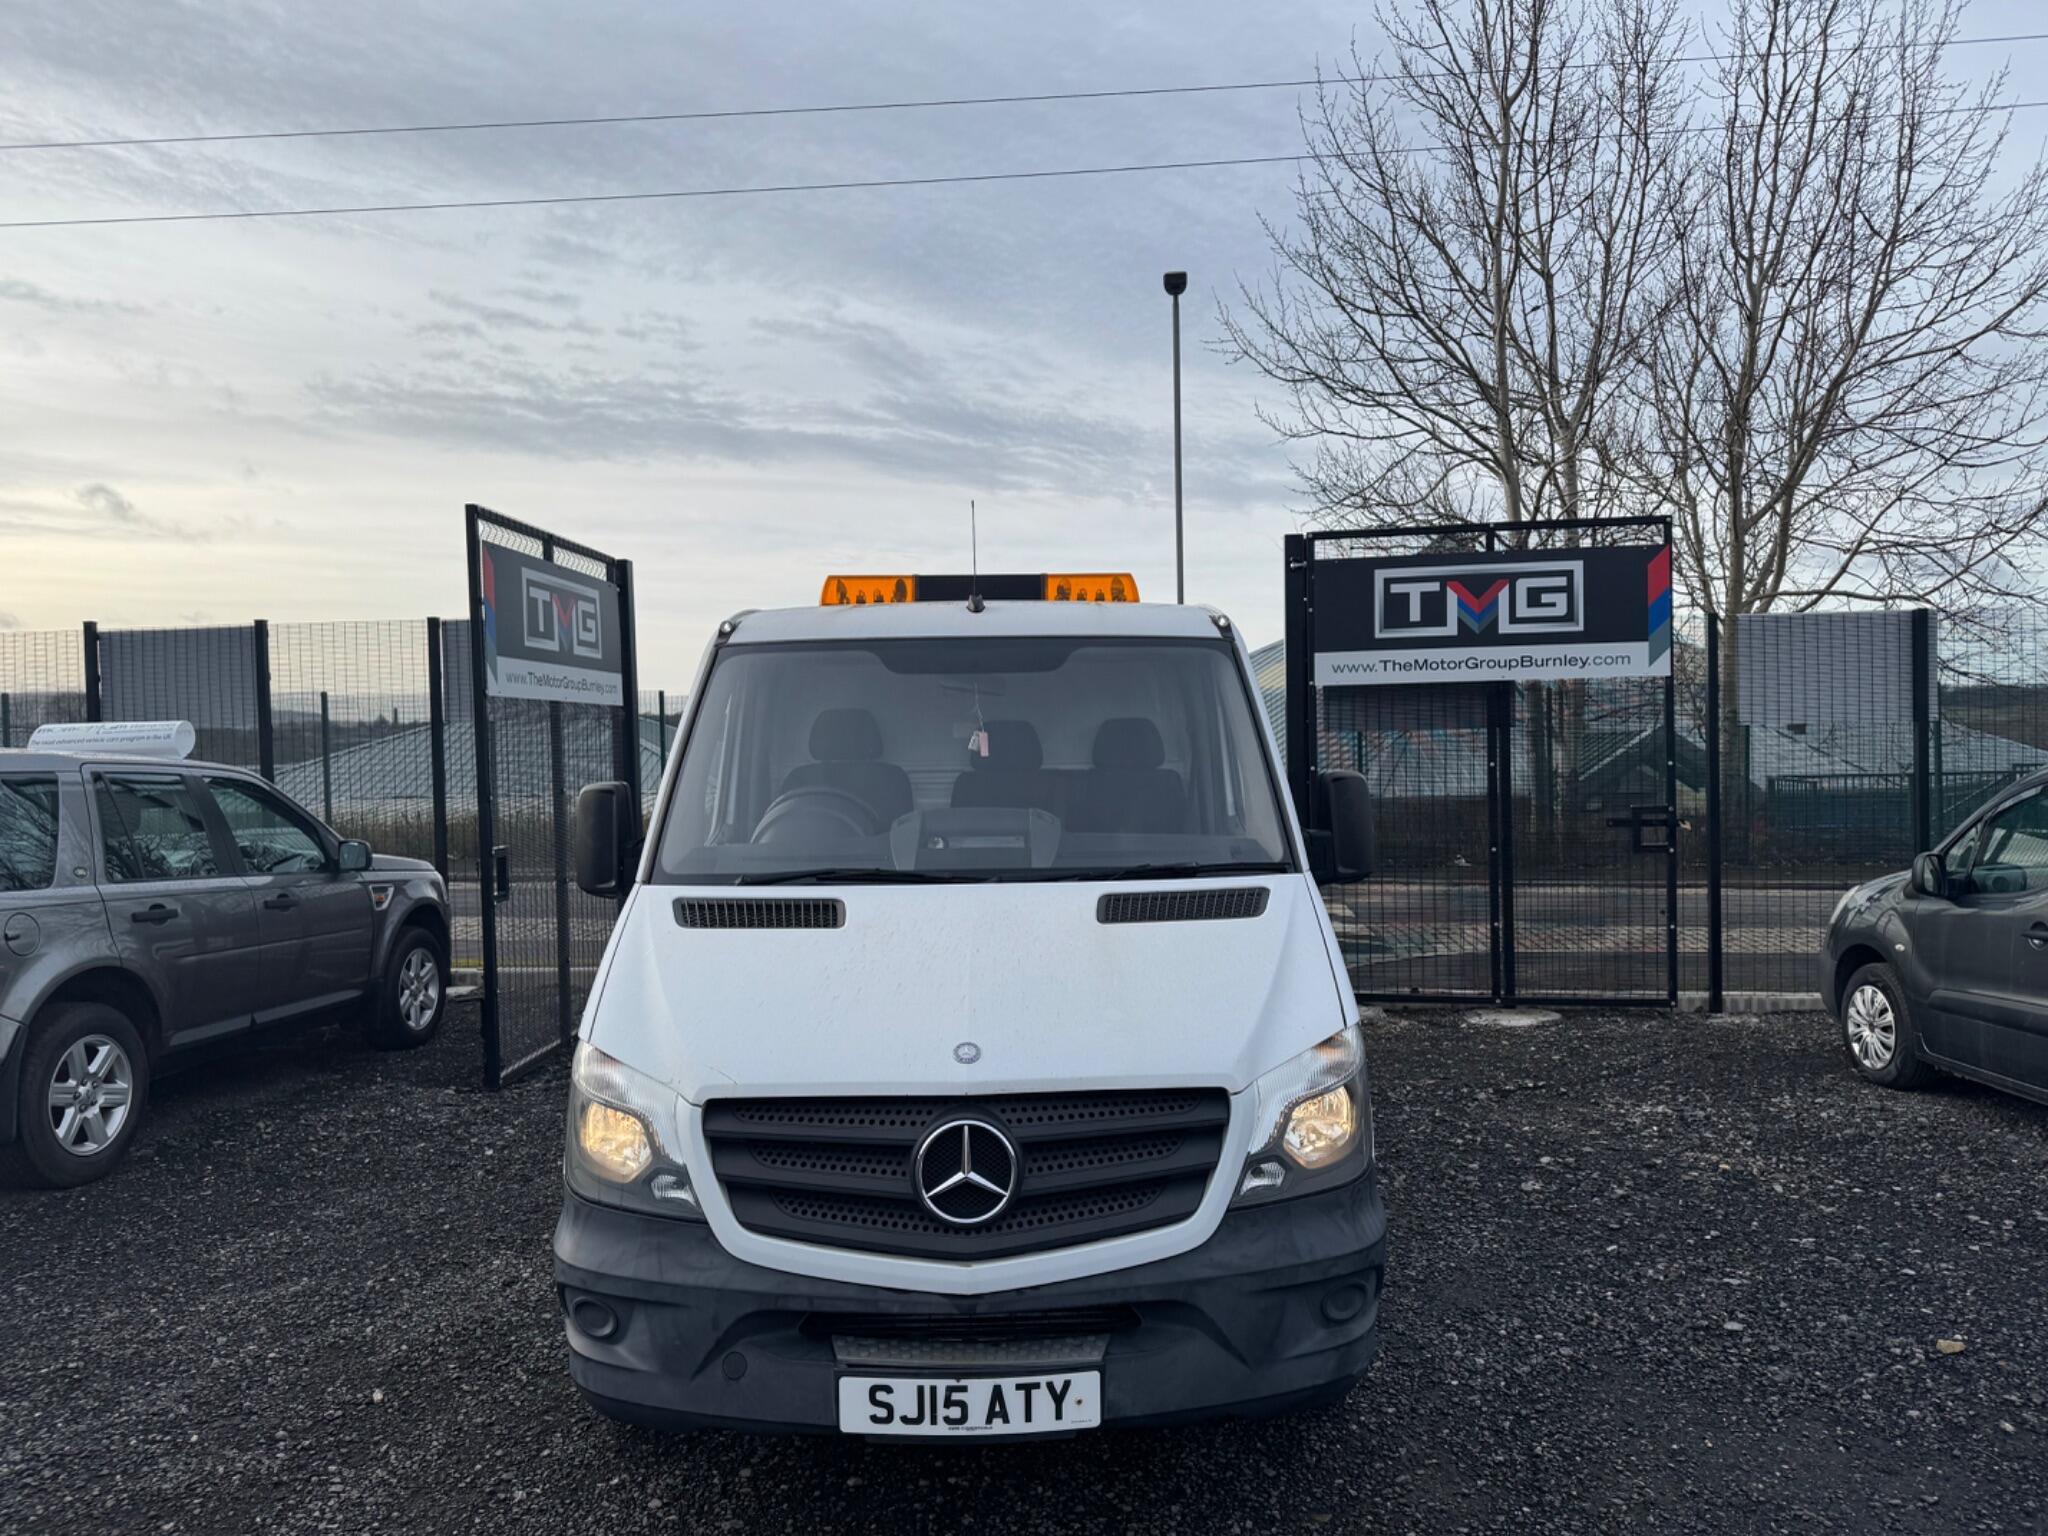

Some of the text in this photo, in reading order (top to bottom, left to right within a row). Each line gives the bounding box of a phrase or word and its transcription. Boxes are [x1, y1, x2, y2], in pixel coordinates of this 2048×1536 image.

[528, 586, 597, 652] TMG
[1390, 576, 1568, 634] TMG
[1331, 653, 1632, 674] www.TheMotorGroupBurnley.com
[868, 1379, 1072, 1426] SJ15 ATY
